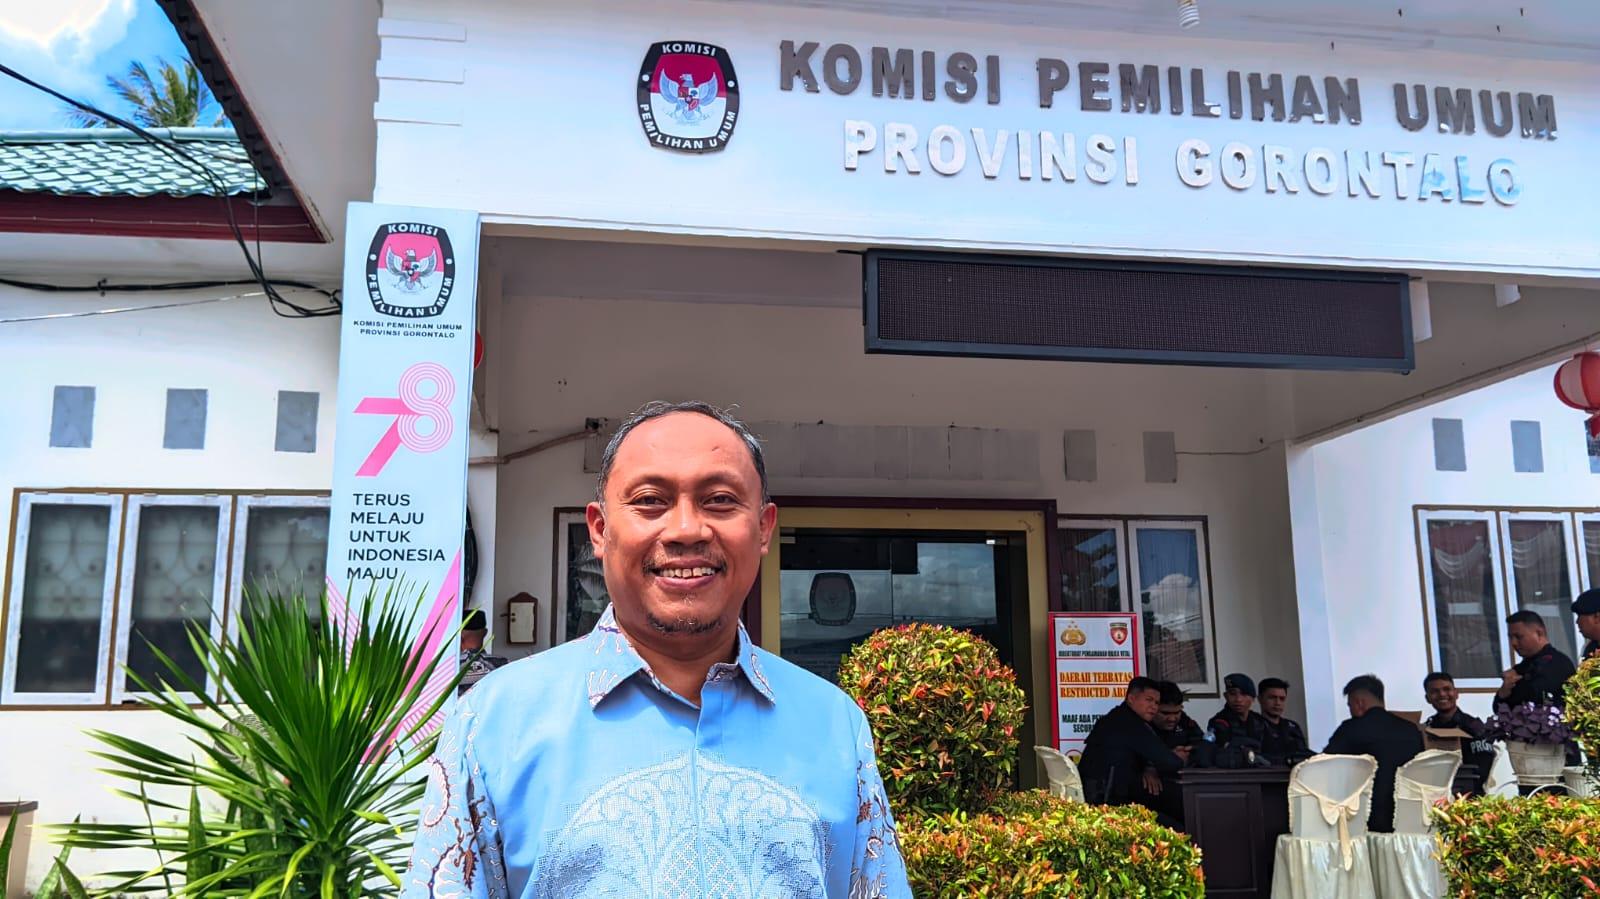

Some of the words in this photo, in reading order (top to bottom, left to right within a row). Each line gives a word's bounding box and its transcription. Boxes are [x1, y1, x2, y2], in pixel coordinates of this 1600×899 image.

[662, 44, 716, 56] KOMISI
[779, 40, 1001, 105] KOMISI
[1036, 58, 1362, 125] PEMILIHAN
[1393, 83, 1558, 141] UMUM
[640, 103, 704, 149] PEMILIHAN
[709, 110, 736, 147] UMUM
[843, 119, 1138, 186] PROVINSI
[1176, 138, 1522, 207] GORONTALO
[388, 224, 438, 236] KOMISI
[368, 273, 425, 316] PEMILIHAN
[429, 277, 453, 315] UMUM
[352, 362, 455, 477] 78
[352, 493, 411, 507] TERUS
[350, 511, 425, 525] MELAJU
[349, 530, 411, 543] UNTUK
[348, 548, 446, 562] INDONESIA
[346, 567, 399, 580] MAJU
[1060, 672, 1091, 682] DAERAH
[1093, 672, 1132, 682] TERBATAS
[1060, 687, 1110, 698] RESTRICTED
[1112, 687, 1128, 698] ARE
[1062, 714, 1078, 723] MAAF
[1079, 714, 1091, 723] ADA
[1073, 724, 1095, 733] SECUR
